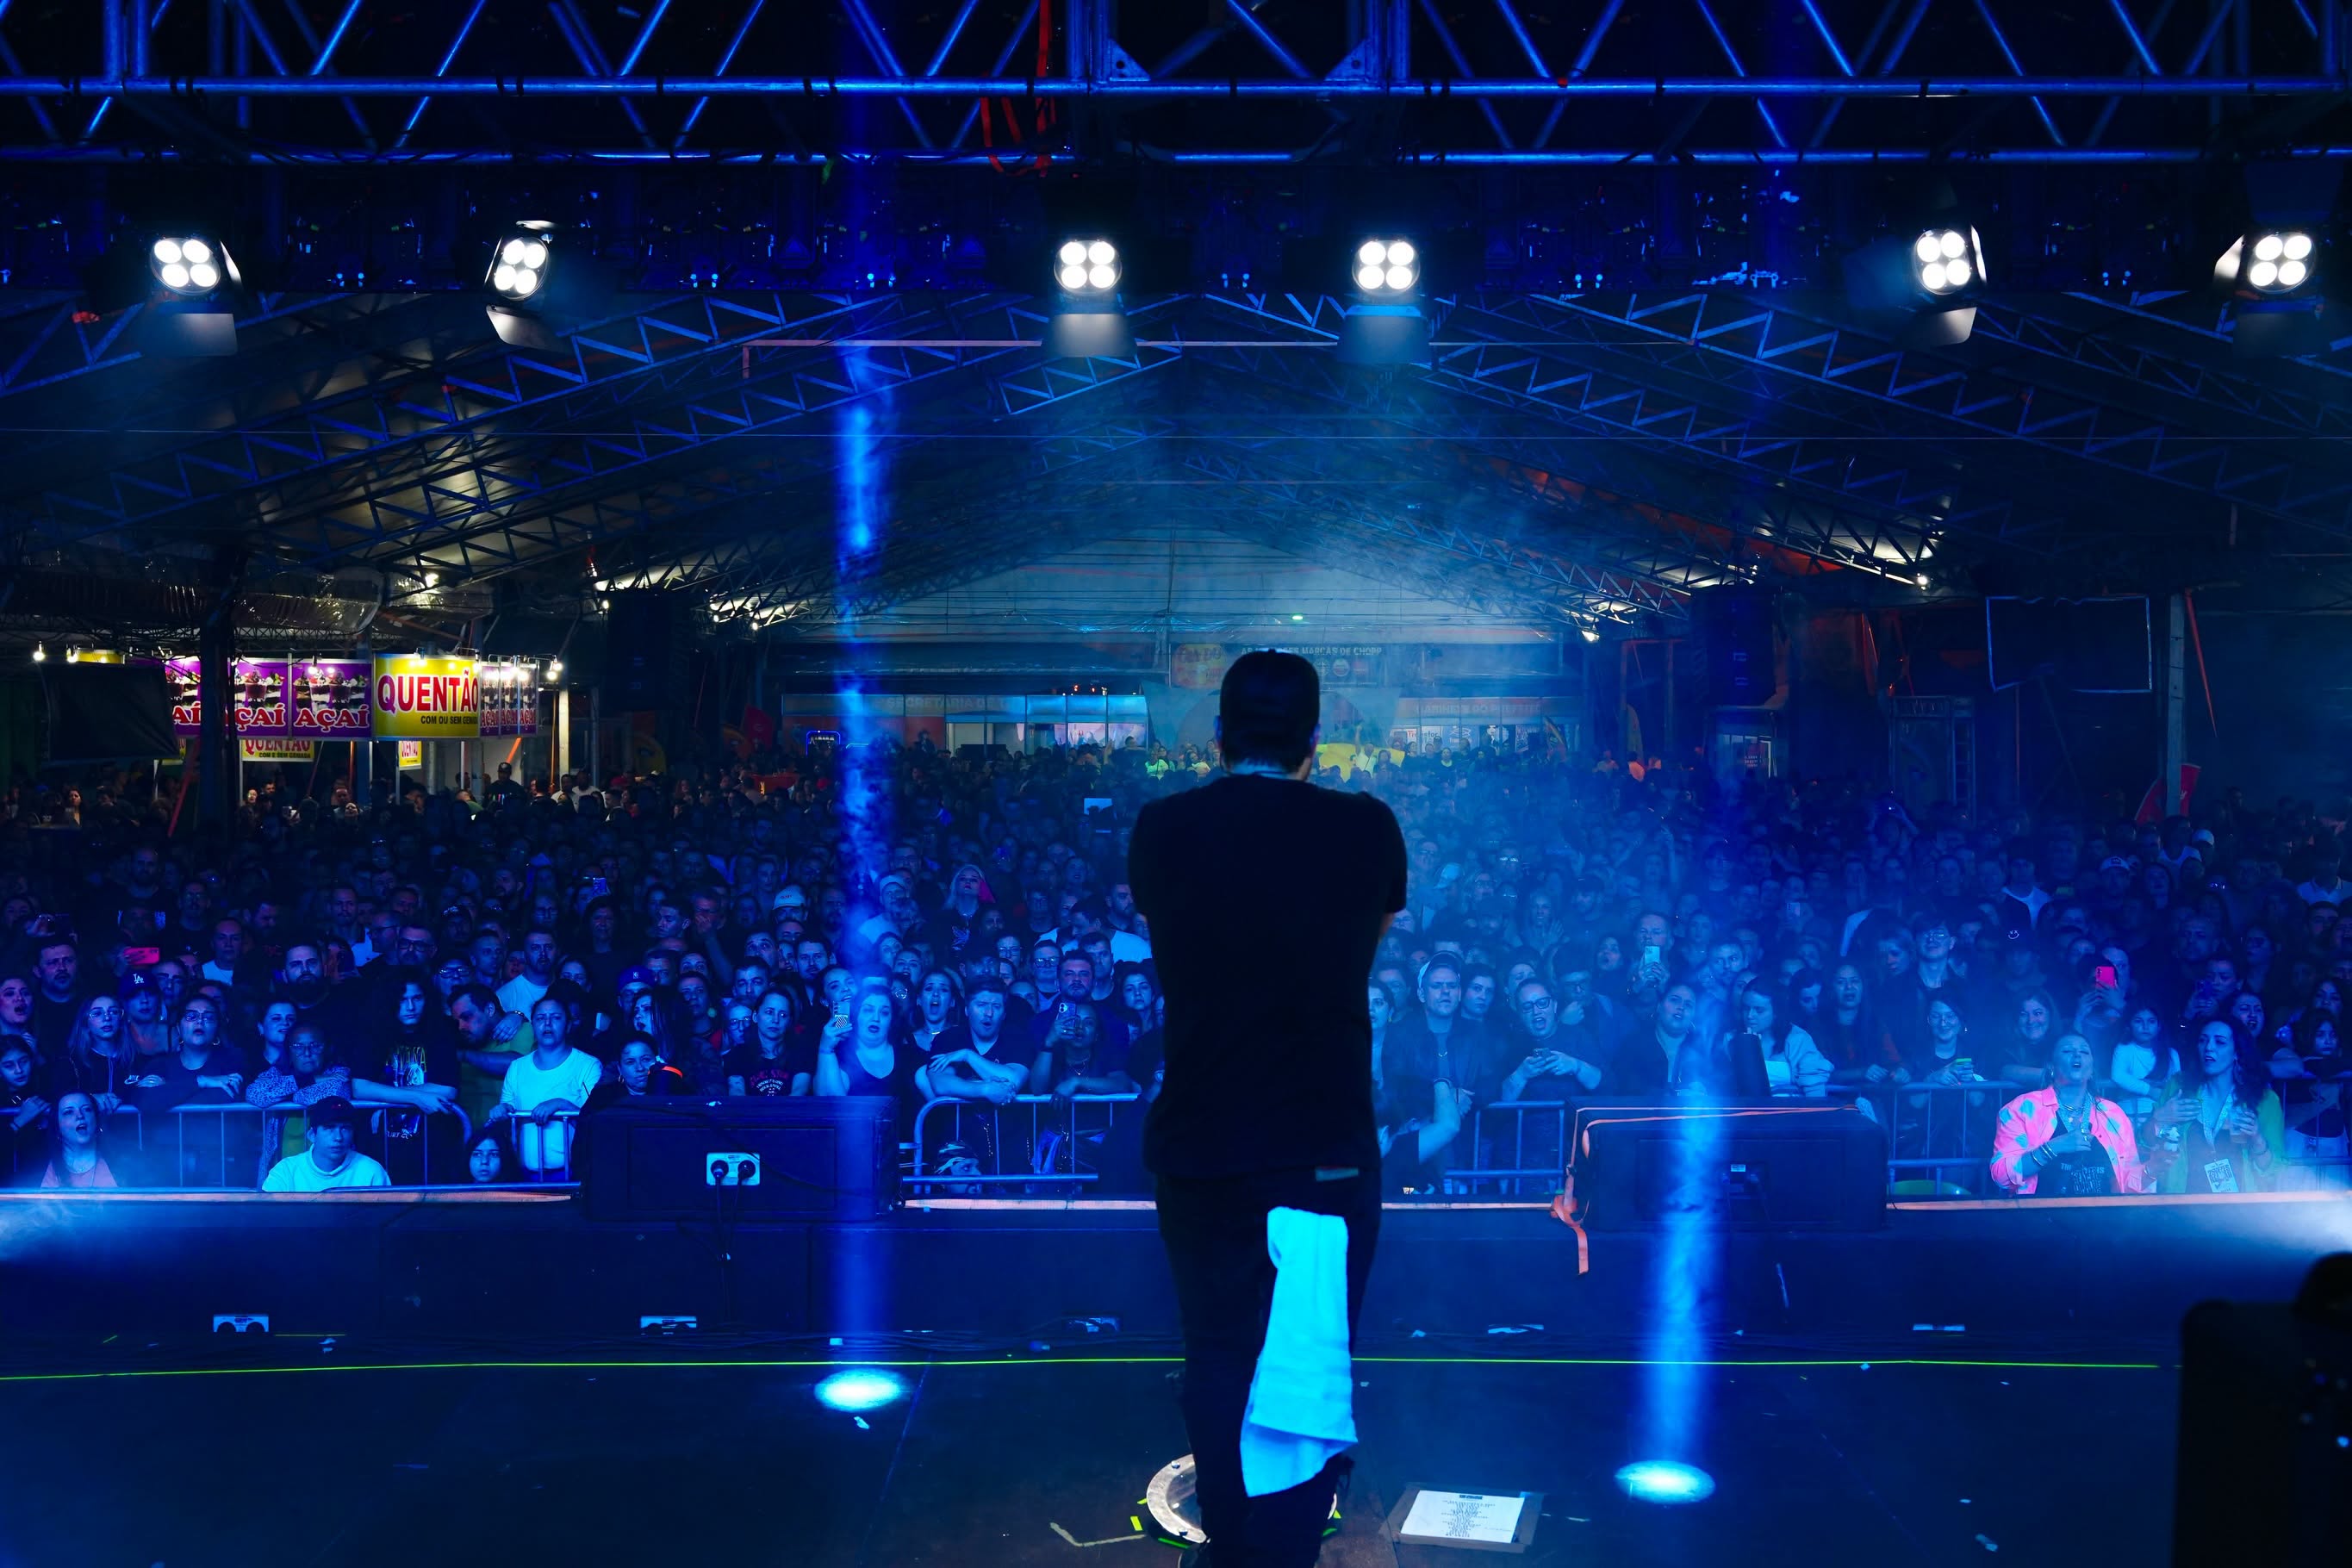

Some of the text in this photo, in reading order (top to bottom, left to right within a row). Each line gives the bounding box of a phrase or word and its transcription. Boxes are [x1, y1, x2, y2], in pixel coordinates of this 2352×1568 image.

[1353, 647, 1382, 656] CHOPP
[377, 672, 479, 715] QUENTÃO
[173, 701, 201, 725] AÍ
[225, 703, 285, 731] ÇAÍ
[294, 705, 370, 732] AÇAÍ
[420, 715, 437, 725] COM
[439, 716, 448, 725] OU
[450, 716, 462, 725] SEM
